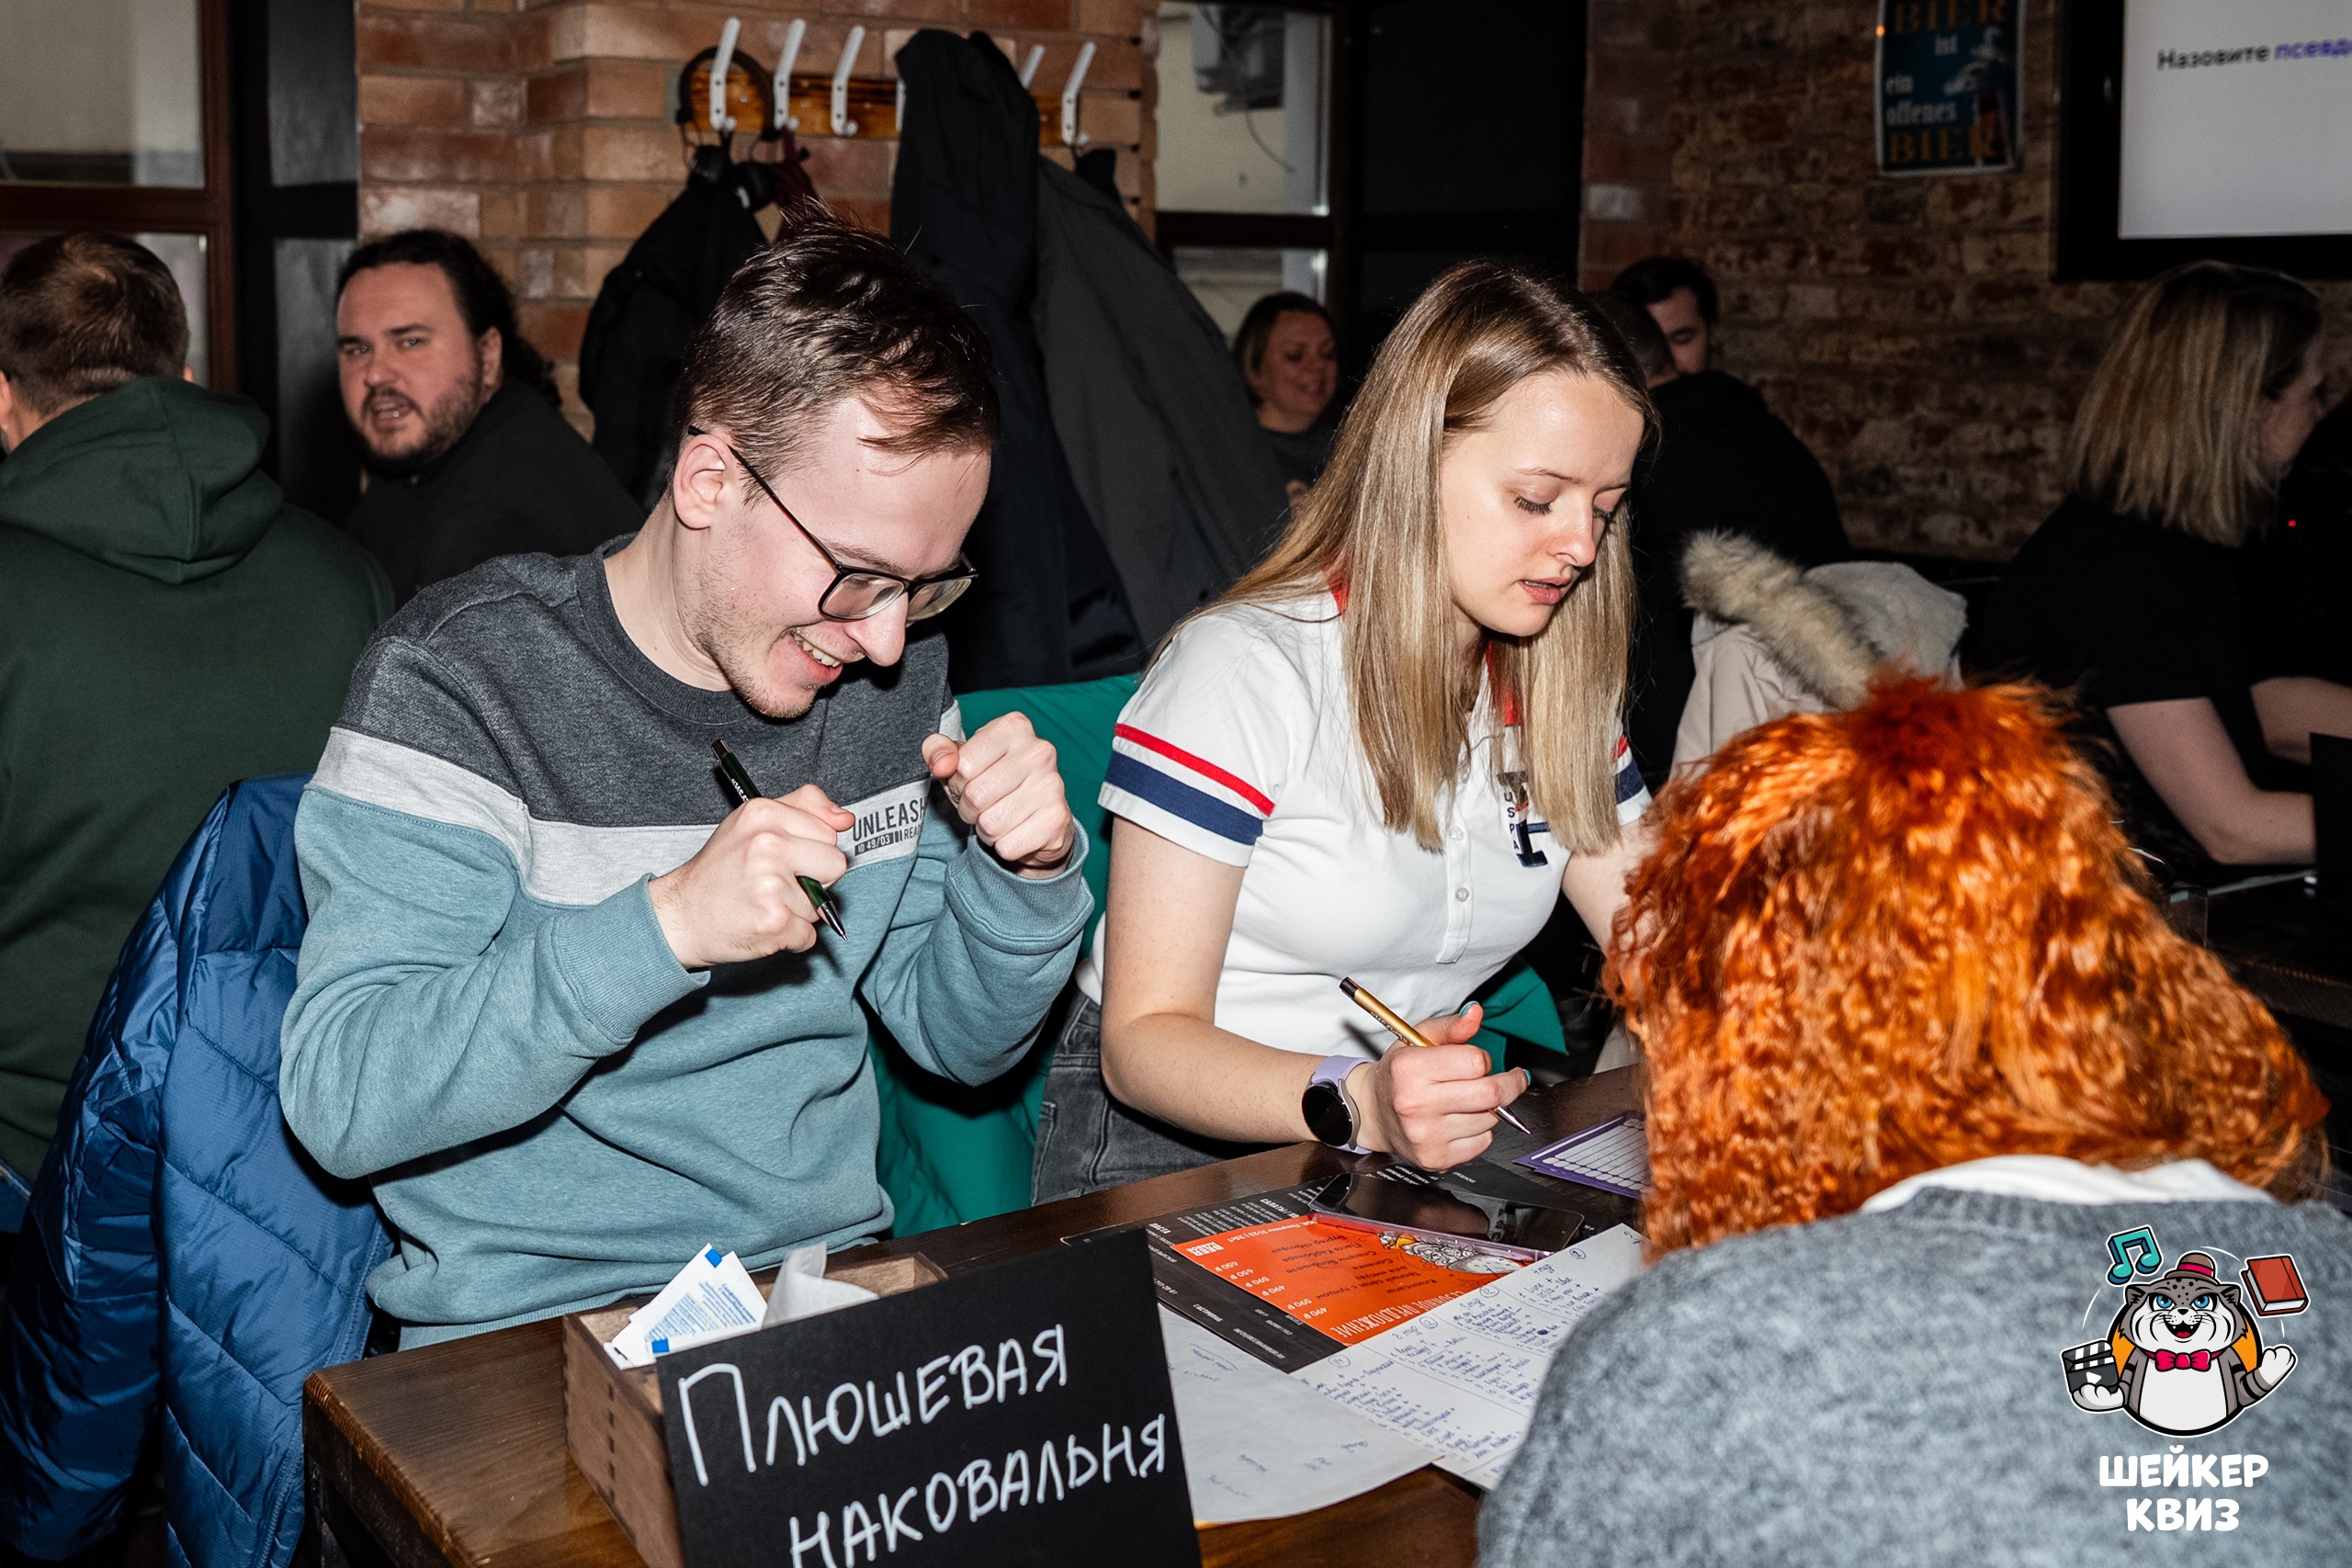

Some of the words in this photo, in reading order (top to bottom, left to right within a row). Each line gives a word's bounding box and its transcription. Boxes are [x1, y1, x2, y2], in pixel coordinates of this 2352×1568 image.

[2157, 46, 2270, 71] Назовите
[2275, 38, 2352, 61] псевд
[1890, 126, 2001, 163] BIER
[1193, 1244, 1225, 1257] BEER
[1253, 1276, 1270, 1286] 590
[1270, 1285, 1285, 1294] 490
[1296, 1298, 1312, 1307] 590
[1312, 1307, 1329, 1317] 490
[1329, 1303, 1420, 1338] ПРЕДЛОЖЕНИЕ
[678, 1324, 1066, 1486] ПЛЮШЕВАЯ
[788, 1414, 1165, 1568] НАКОВАЛЬНЯ
